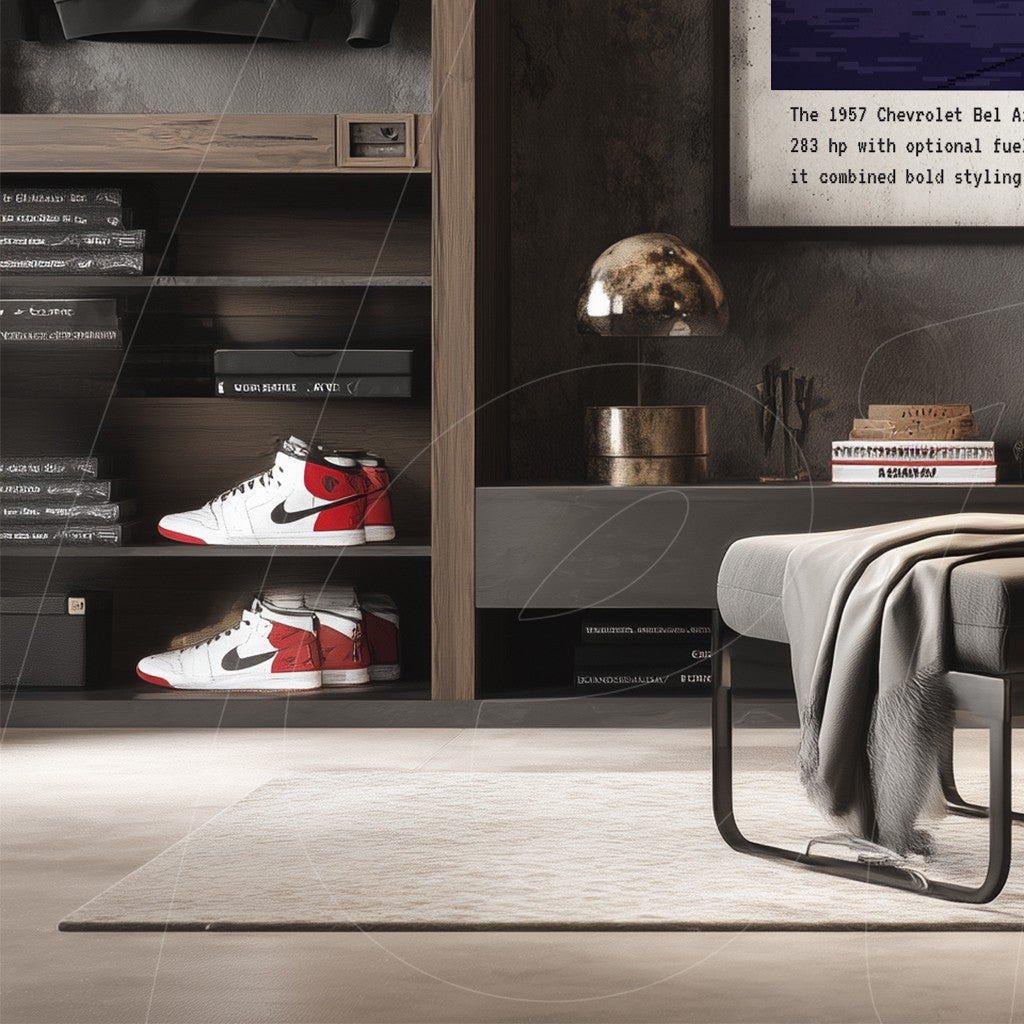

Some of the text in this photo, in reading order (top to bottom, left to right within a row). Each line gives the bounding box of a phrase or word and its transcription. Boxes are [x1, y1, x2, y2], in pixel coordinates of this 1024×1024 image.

[789, 106, 819, 122] The
[829, 106, 867, 122] 1957
[877, 106, 962, 122] Chevrolet
[973, 107, 1001, 123] Bel
[790, 137, 818, 153] 283
[828, 137, 848, 157] hp
[857, 137, 896, 153] with
[905, 137, 982, 157] optional
[791, 168, 808, 184] it
[819, 168, 896, 184] combined
[905, 168, 944, 184] bold
[954, 168, 1022, 189] styling
